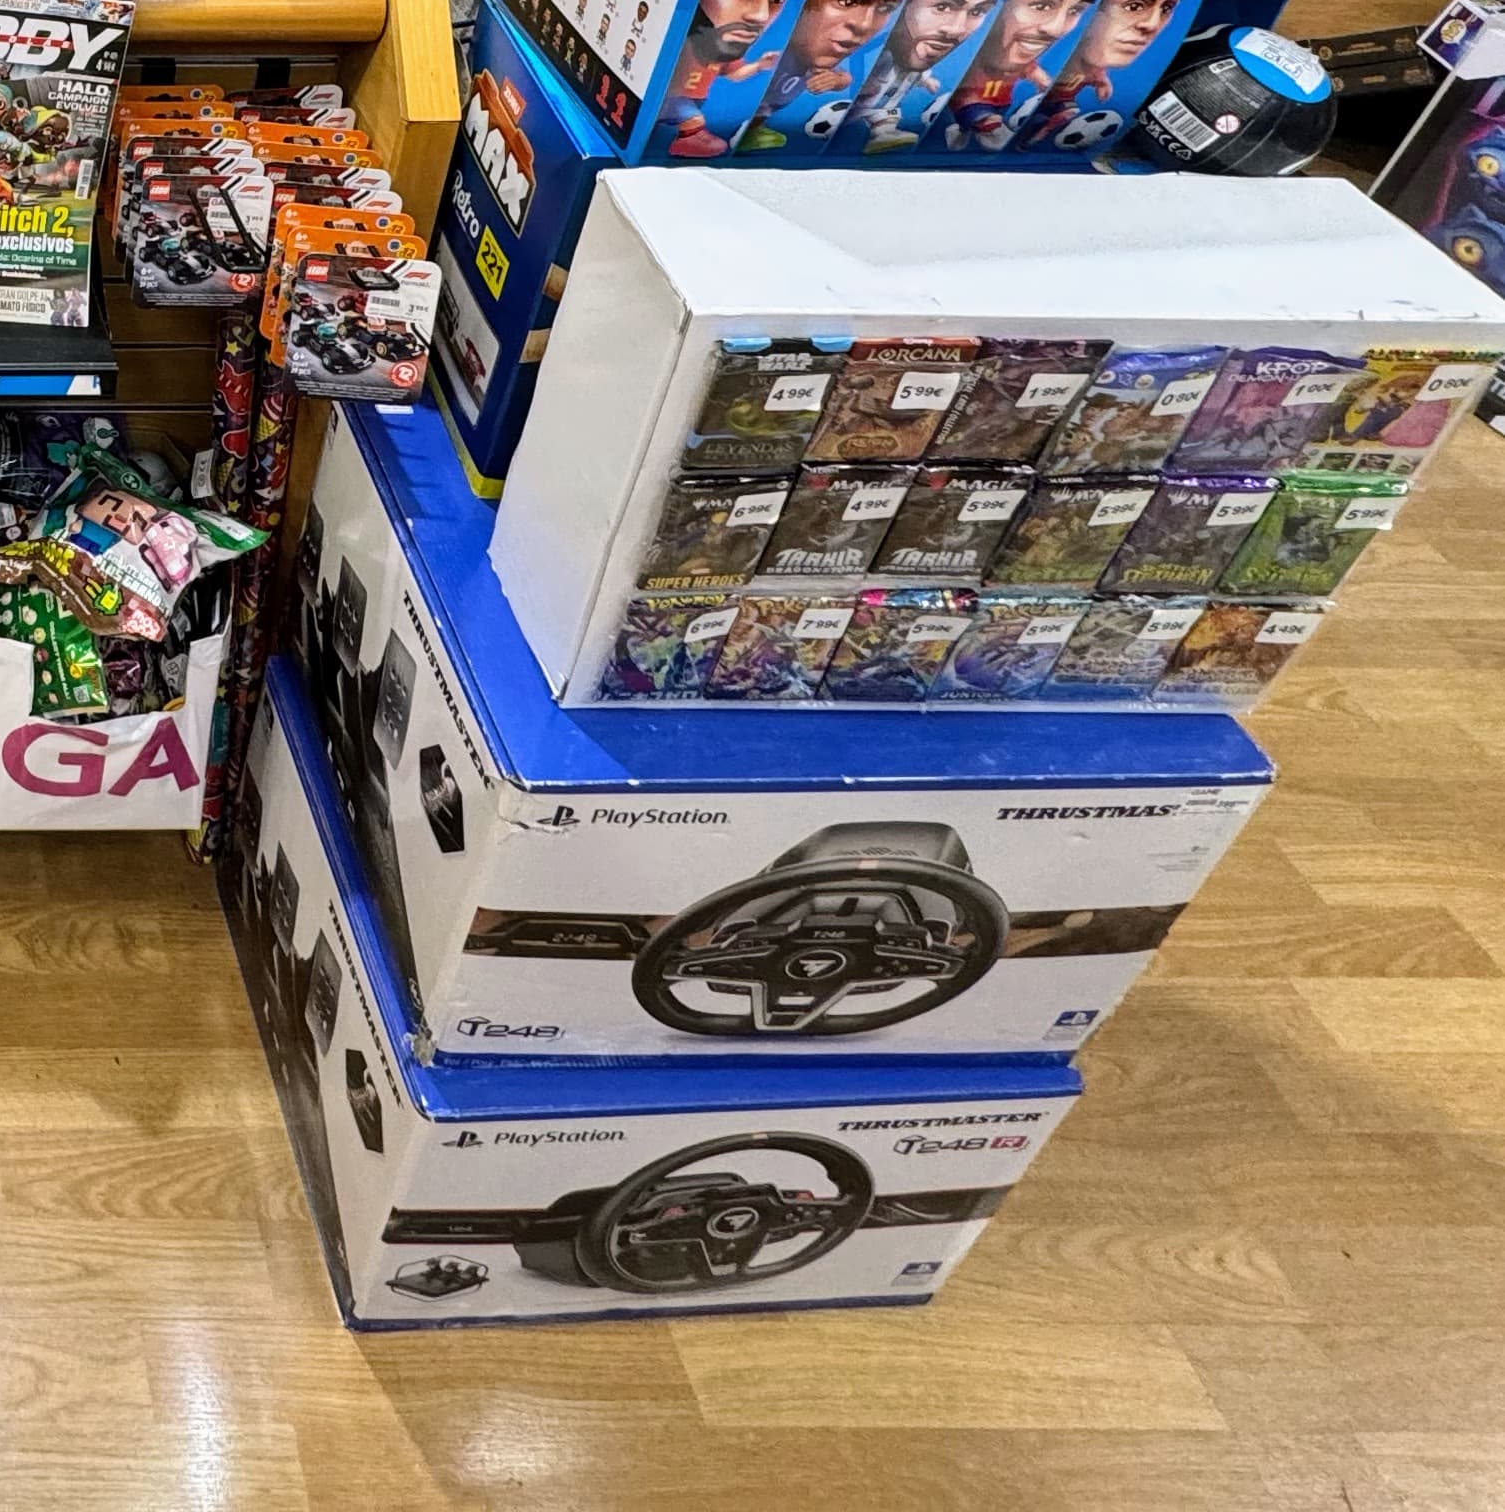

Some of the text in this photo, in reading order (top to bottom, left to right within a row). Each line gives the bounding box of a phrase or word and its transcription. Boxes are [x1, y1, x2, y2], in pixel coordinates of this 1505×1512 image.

[48, 91, 110, 106] CAMPAIGN
[55, 100, 108, 114] EVOLVED
[464, 91, 529, 226] MAX
[452, 169, 480, 238] Retro
[307, 263, 329, 278] LEGO
[481, 240, 504, 284] 221
[867, 348, 961, 362] LORCANA
[776, 548, 863, 566] TARKIR
[403, 590, 492, 789] THRUSTMASTER
[591, 809, 729, 827] PlayStation
[996, 805, 1180, 820] THRUSTMAS
[466, 1019, 560, 1038] T248
[838, 1112, 1042, 1131] THRUSTMASTER
[495, 1129, 628, 1149] PlayStation
